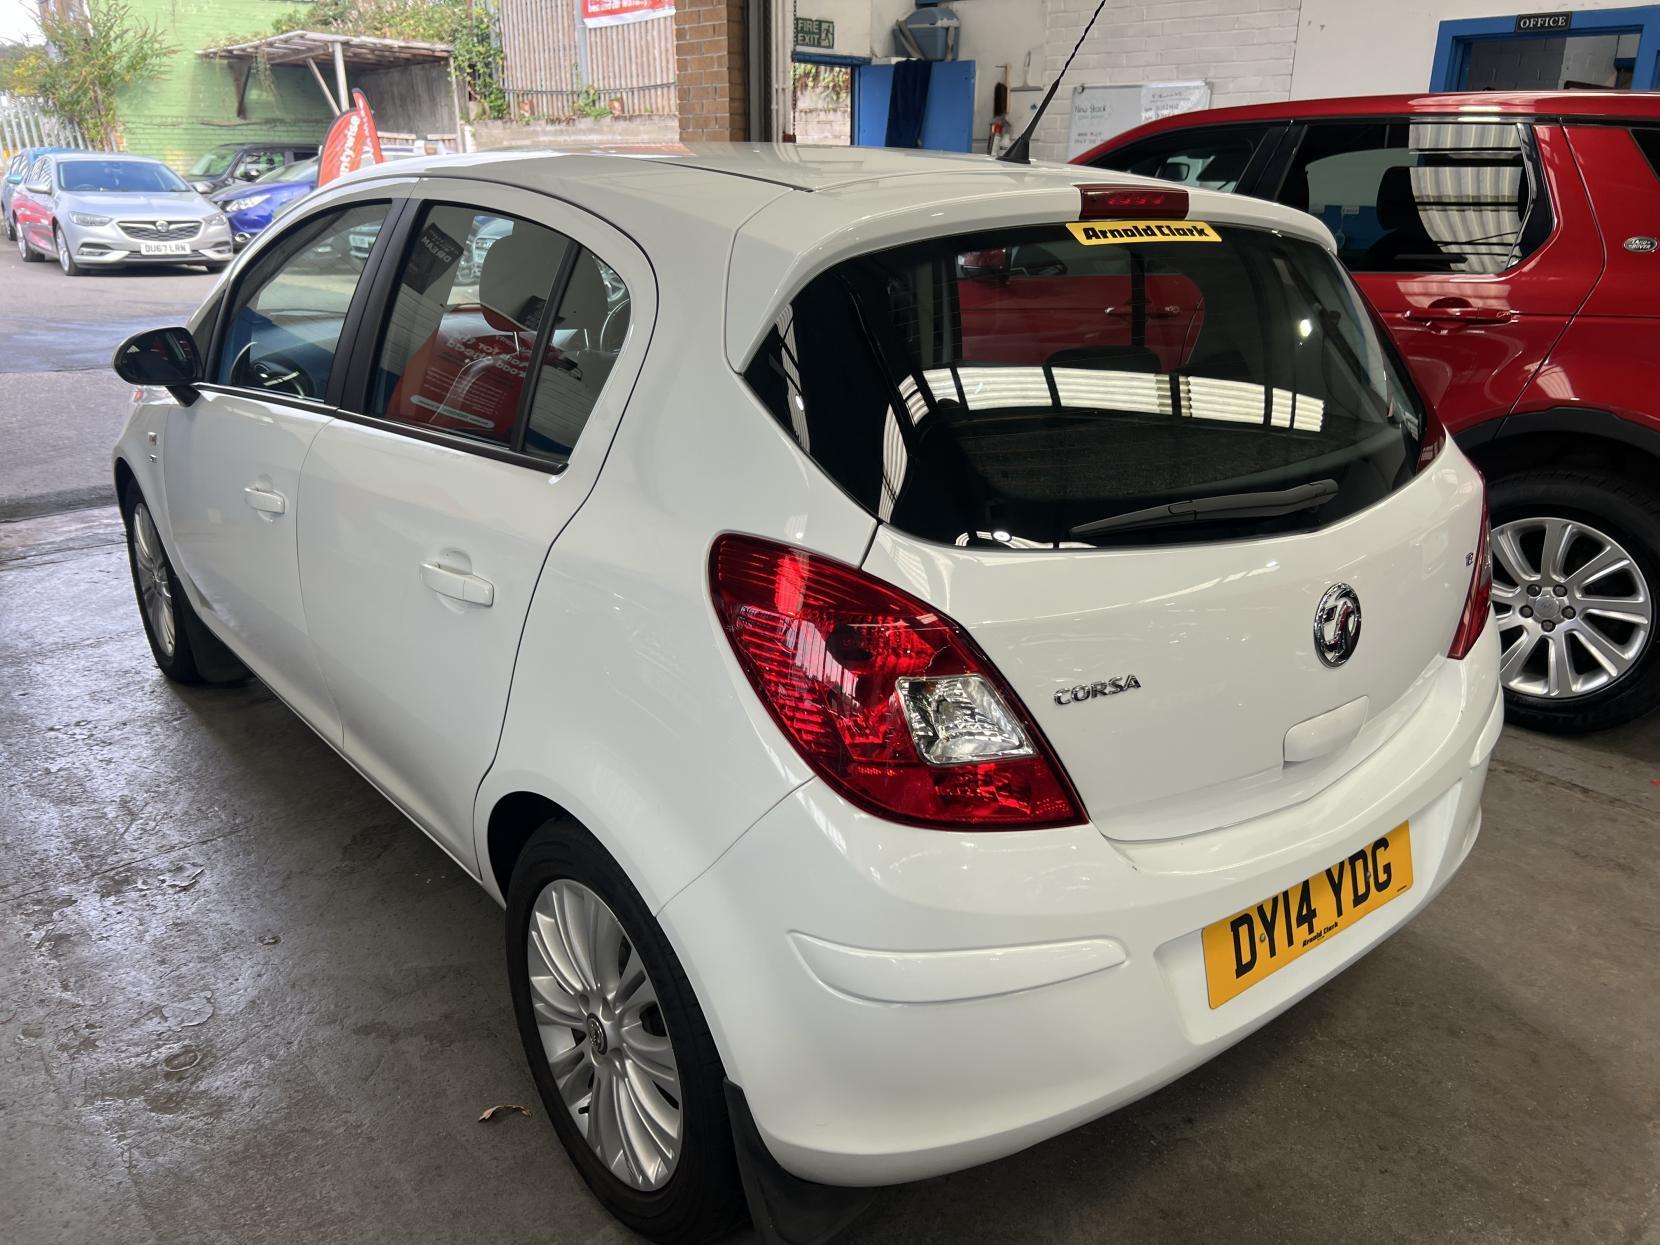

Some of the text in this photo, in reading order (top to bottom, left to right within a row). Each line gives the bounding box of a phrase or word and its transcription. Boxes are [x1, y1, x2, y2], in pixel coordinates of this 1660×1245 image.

[798, 20, 819, 32] FIRE
[1520, 16, 1566, 28] OFFICE
[798, 34, 819, 46] EXIT
[339, 115, 361, 177] ntywise
[1083, 224, 1210, 240] Arnold Clark
[1054, 674, 1141, 705] CORSA
[1230, 837, 1392, 980] DY14 YDG
[1302, 930, 1323, 947] Arnold
